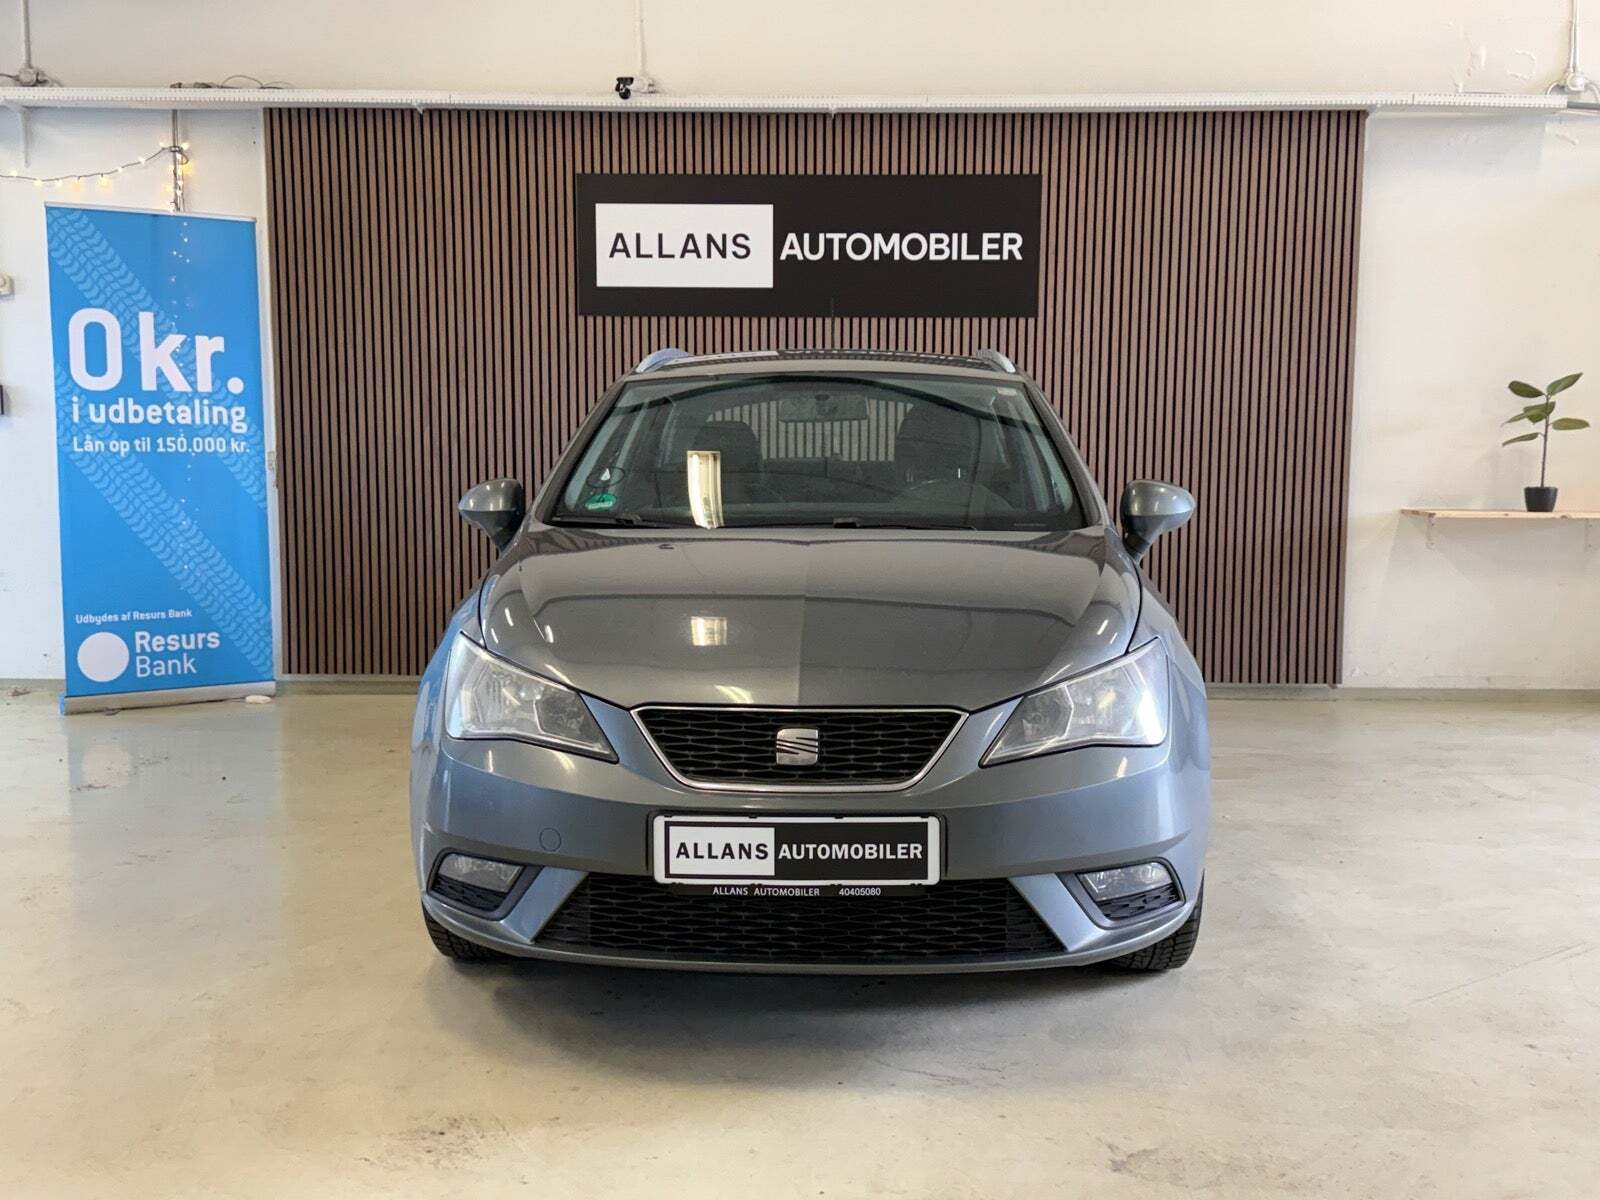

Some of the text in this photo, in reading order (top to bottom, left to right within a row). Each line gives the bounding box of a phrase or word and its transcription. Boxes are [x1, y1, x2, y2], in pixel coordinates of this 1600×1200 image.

[609, 232, 1023, 261] ALLANS AUTOMOBILER
[138, 311, 245, 394] kr.
[71, 396, 248, 434] i udbetaling
[73, 433, 250, 458] Lån op til 150.000 kr.
[75, 608, 193, 625] Udbydes af Resurs Bank
[134, 630, 221, 653] Resurs
[136, 653, 197, 678] Bank
[676, 842, 923, 860] ALLANS AUTOMOBILER
[712, 886, 882, 897] ALLANS AUTOMOBILER 40405080
